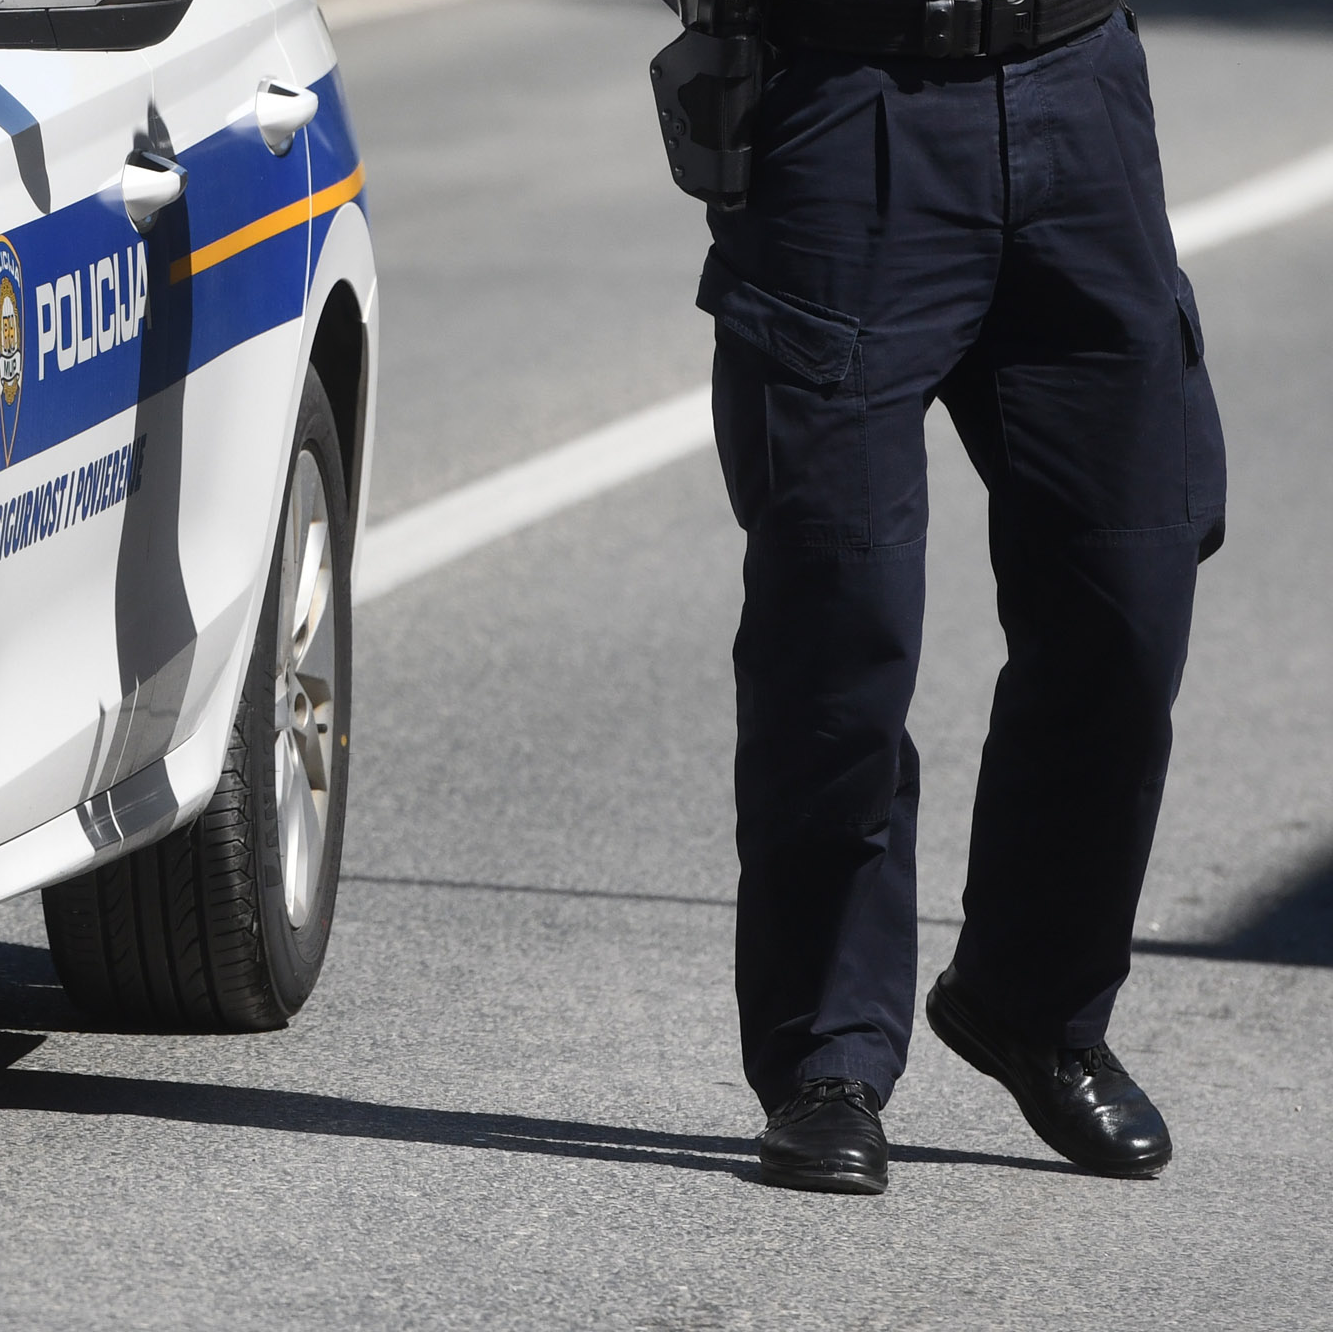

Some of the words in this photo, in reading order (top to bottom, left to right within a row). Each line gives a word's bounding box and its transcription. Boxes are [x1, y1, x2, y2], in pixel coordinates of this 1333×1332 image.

[35, 241, 152, 381] POLICIJA
[64, 471, 76, 530] I
[71, 433, 148, 526] POVJERENJE
